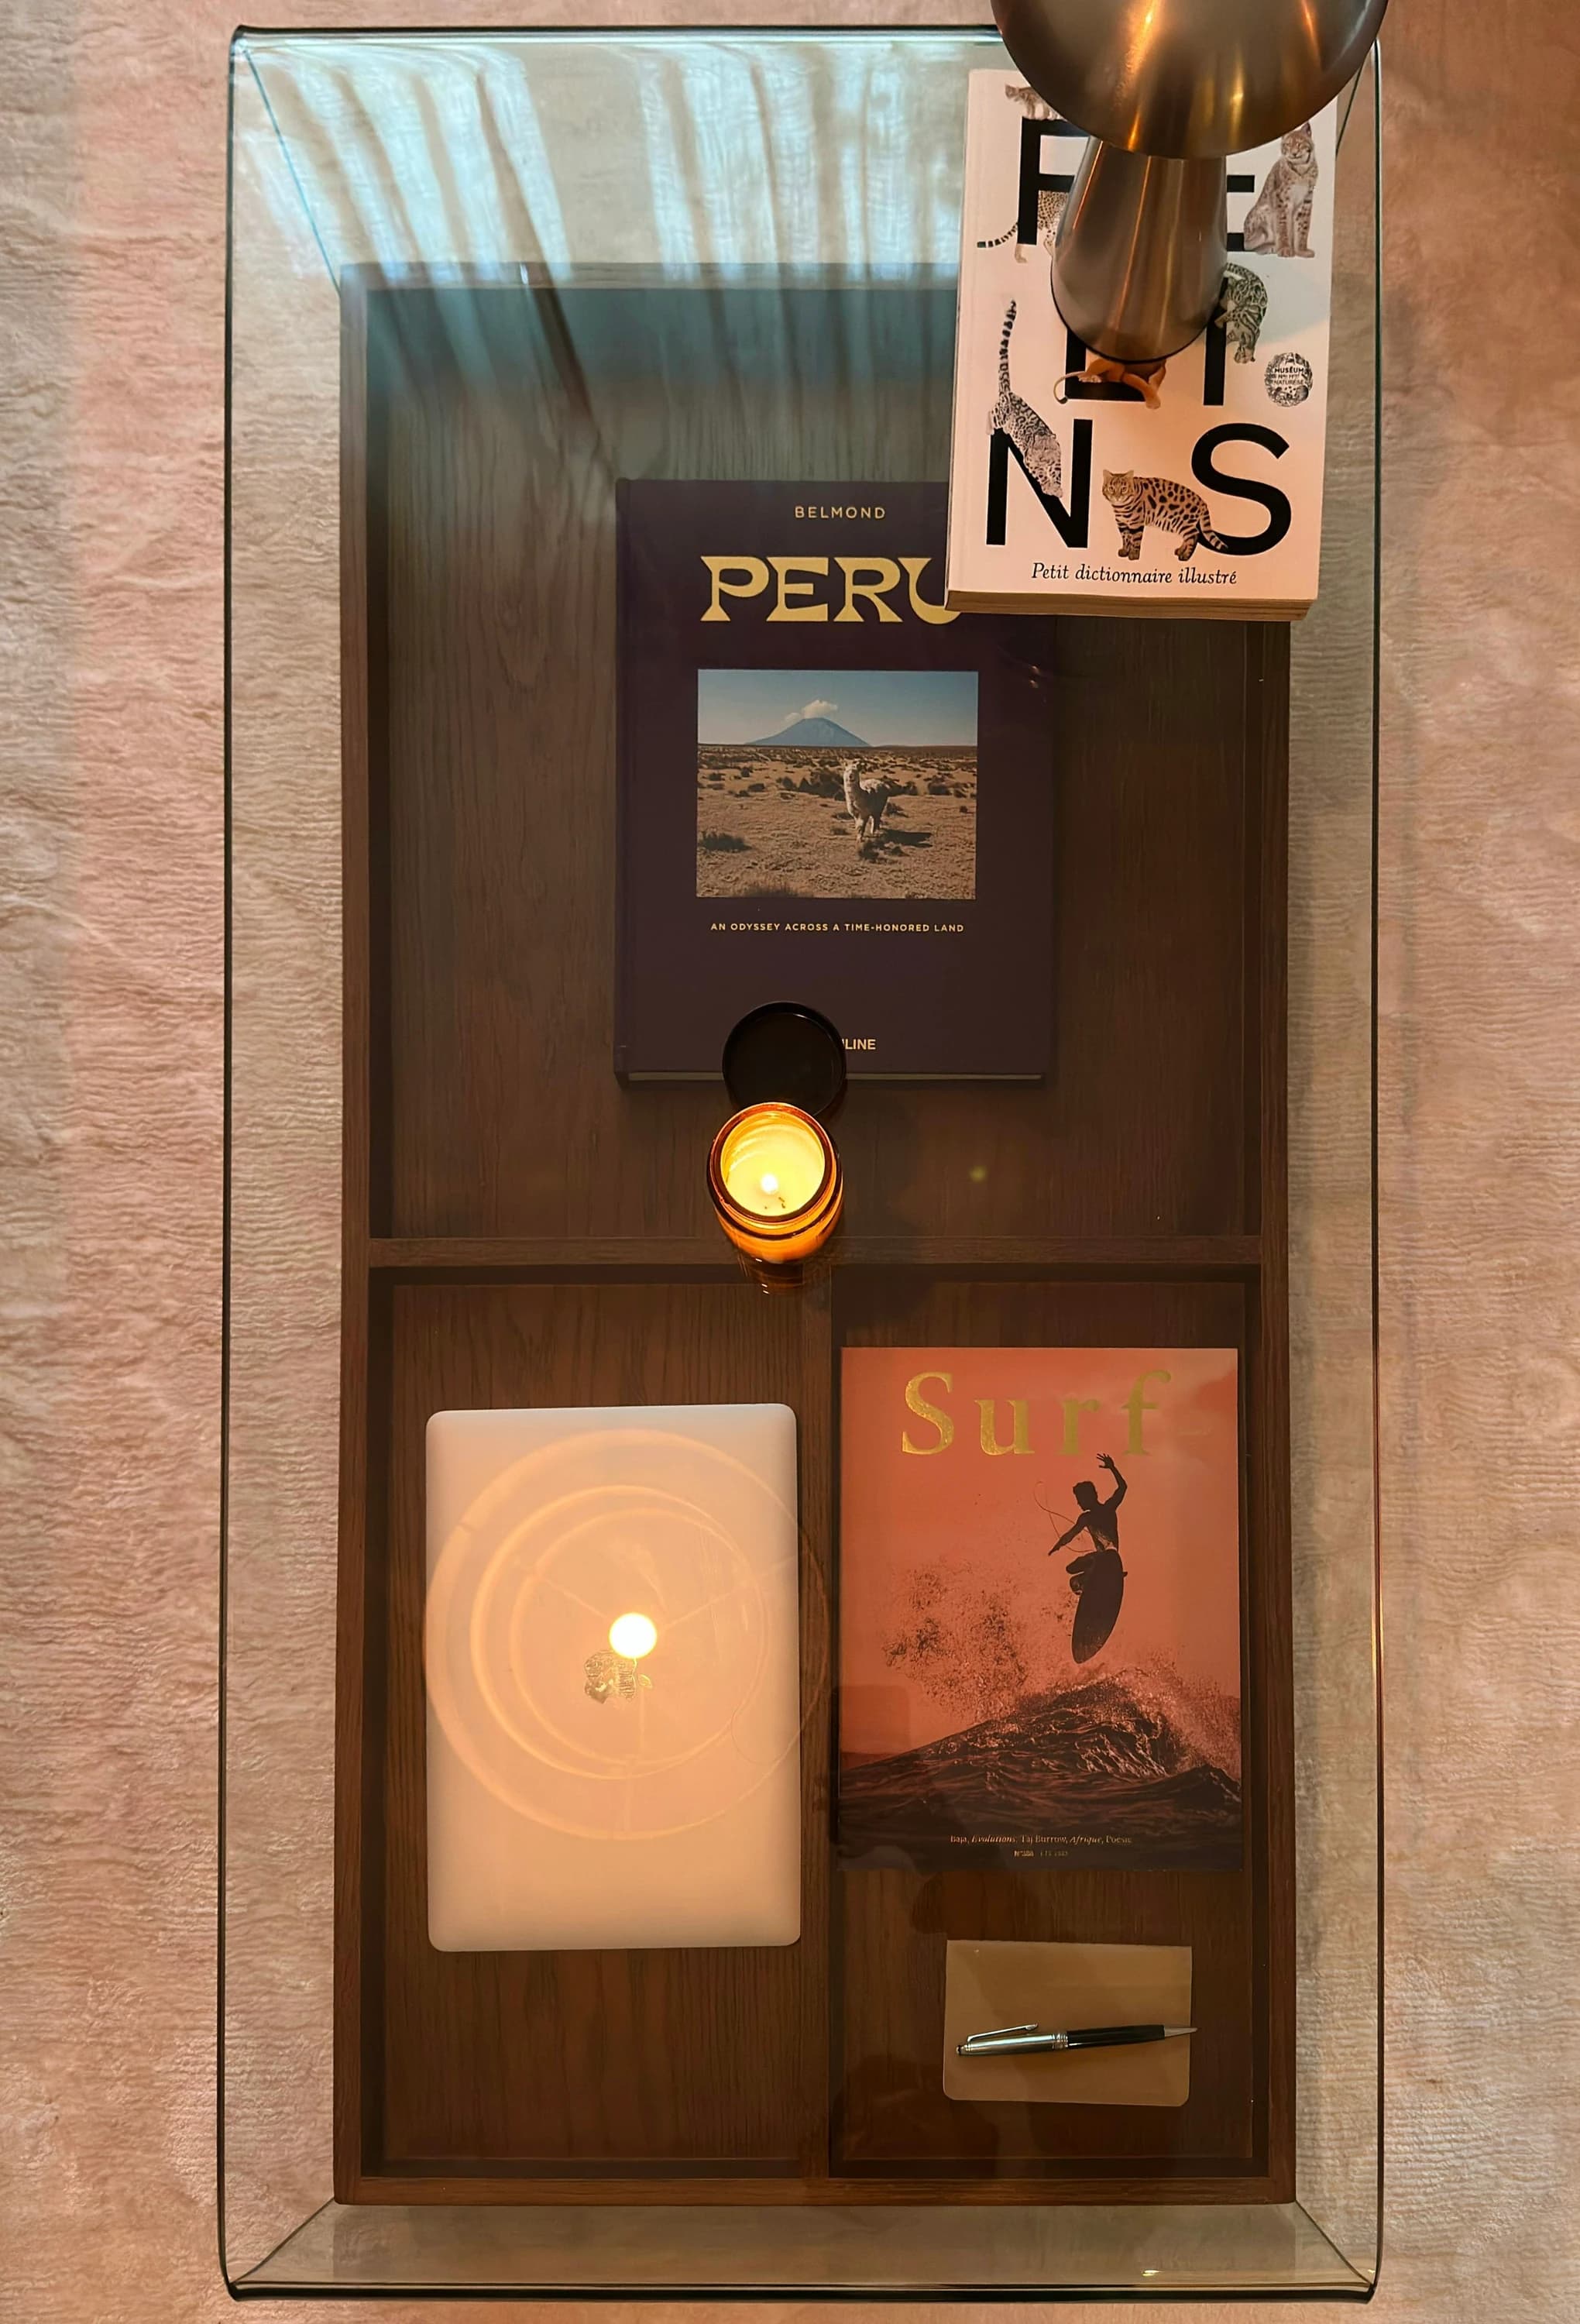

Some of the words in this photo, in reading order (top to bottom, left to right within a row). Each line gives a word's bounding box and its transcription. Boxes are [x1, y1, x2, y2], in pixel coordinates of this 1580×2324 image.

[795, 506, 886, 519] BELMOND
[1031, 562, 1069, 579] Petit
[1075, 563, 1173, 583] dictionnaire
[1178, 566, 1238, 584] illustré
[730, 923, 781, 931] ODYSSEY
[785, 923, 829, 931] ACROSS
[844, 923, 930, 932] TIME-HONORED
[934, 924, 964, 933] LAND
[842, 1038, 877, 1050] LINE
[902, 1370, 1172, 1456] Surf
